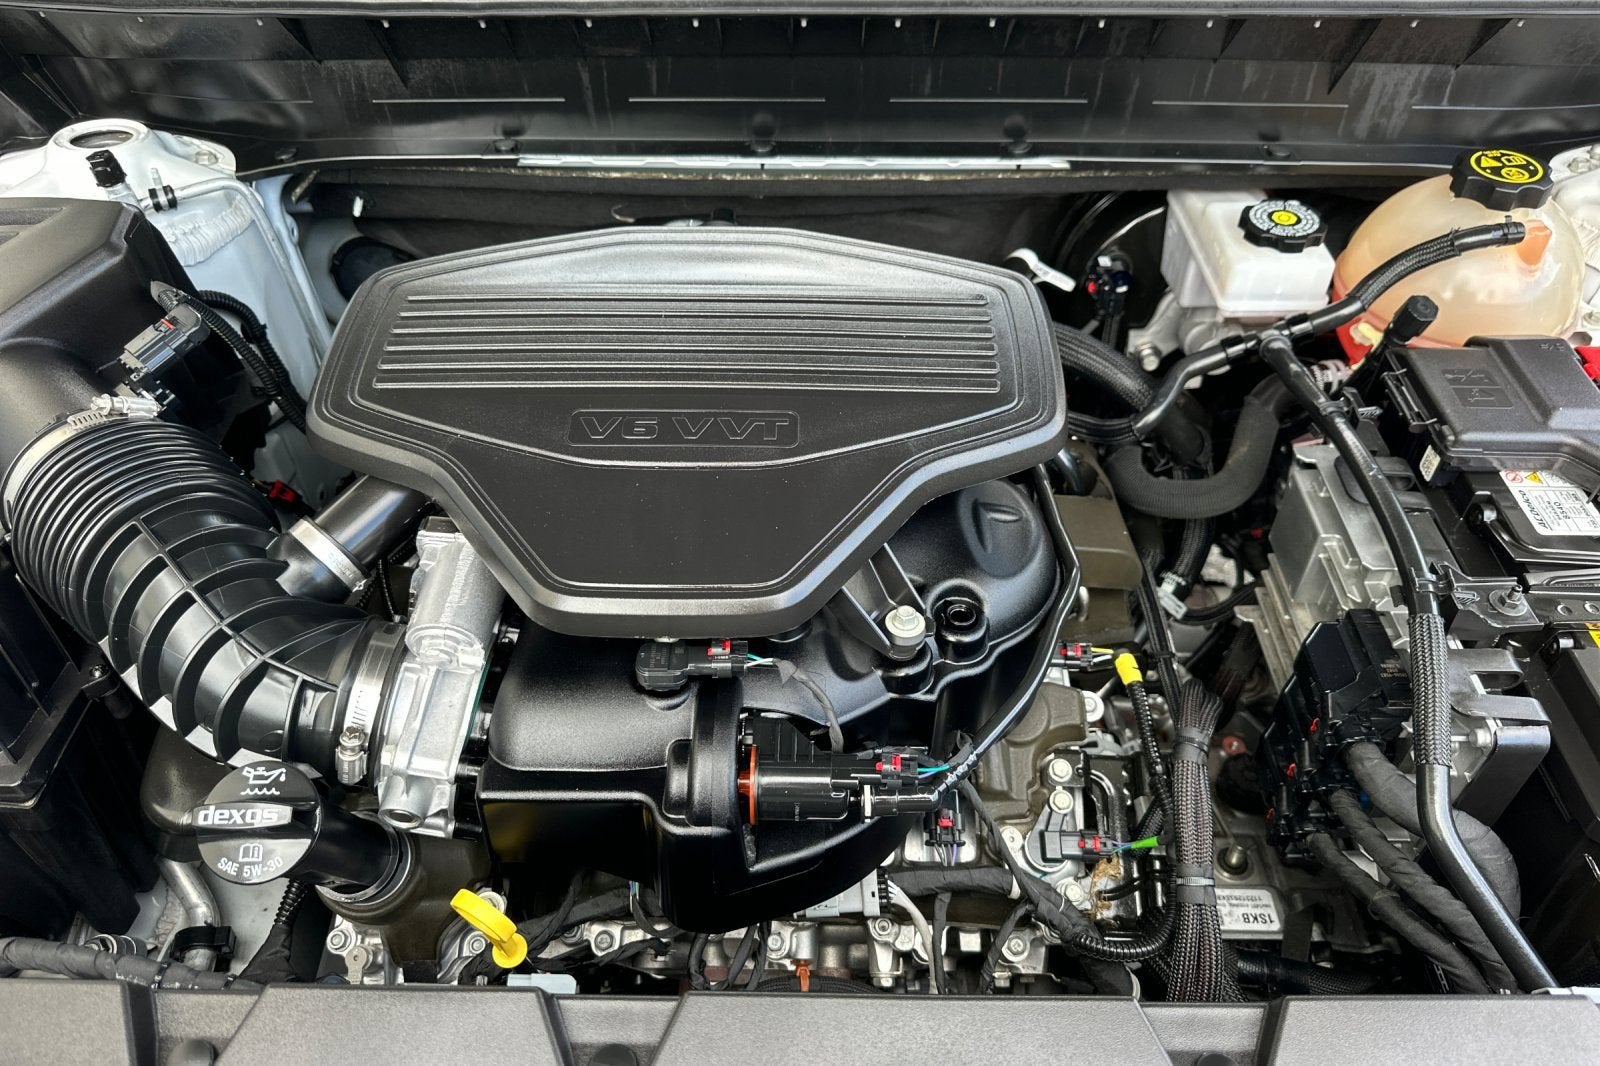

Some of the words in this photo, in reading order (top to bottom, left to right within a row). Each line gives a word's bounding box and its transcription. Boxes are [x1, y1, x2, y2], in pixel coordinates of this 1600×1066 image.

[579, 416, 659, 439] V6
[671, 416, 790, 441] VVT
[217, 856, 240, 876] SAE
[242, 856, 284, 878] 5W-30
[1241, 912, 1276, 925] 1SKB
